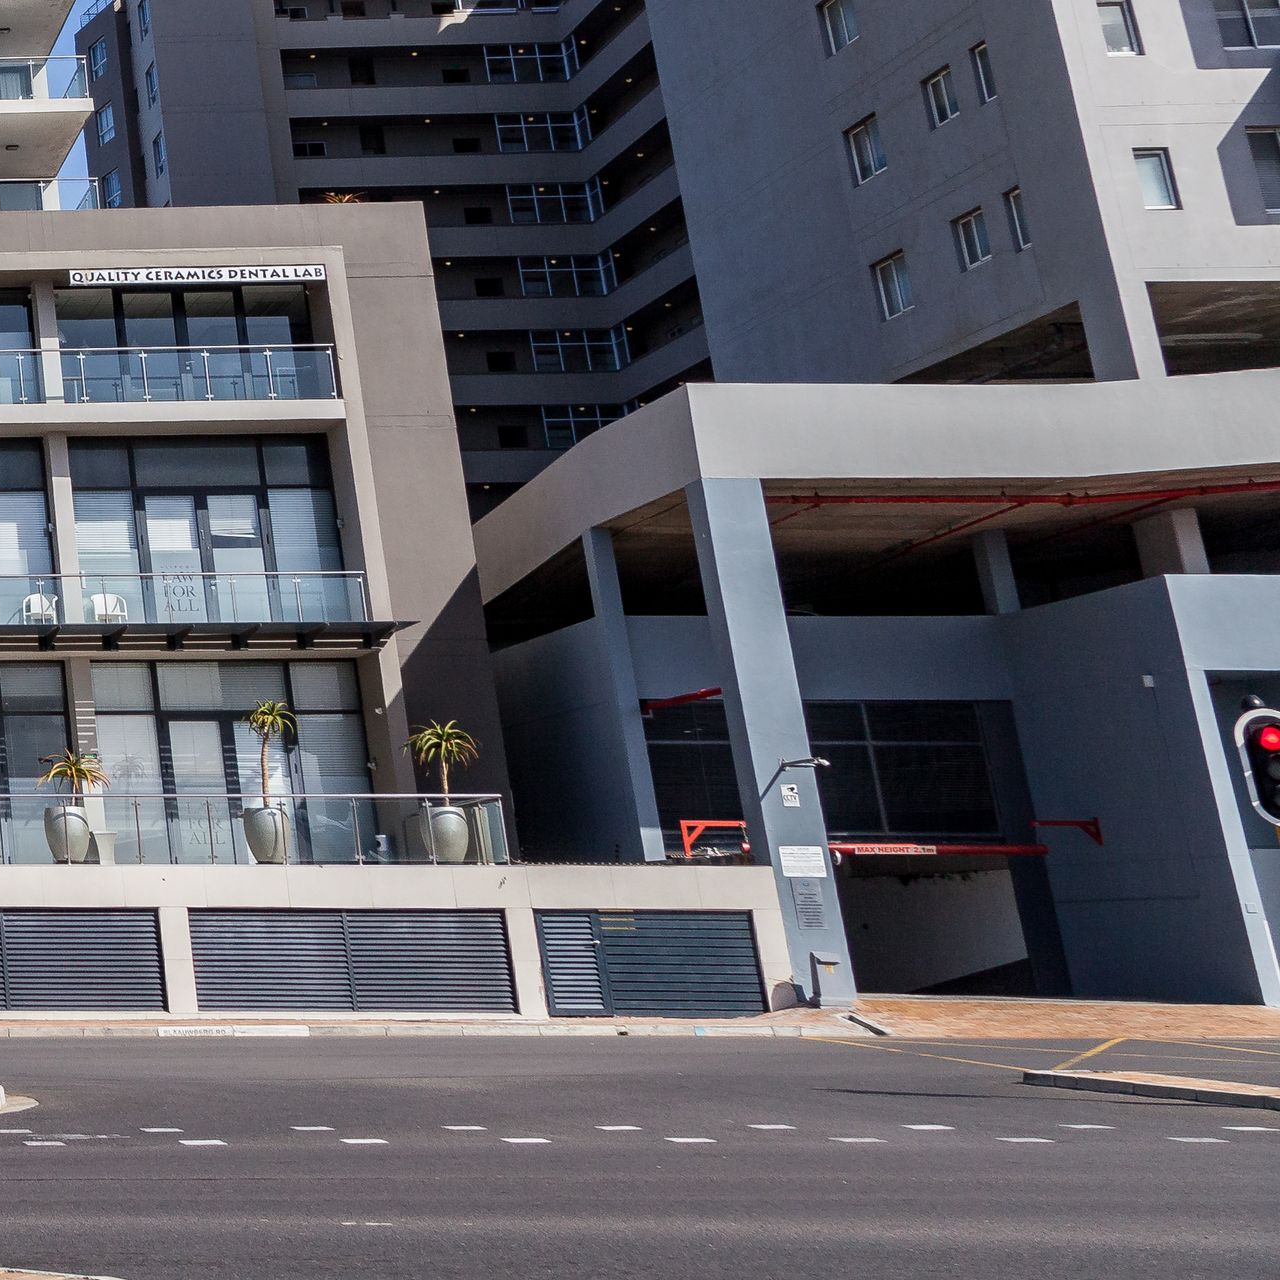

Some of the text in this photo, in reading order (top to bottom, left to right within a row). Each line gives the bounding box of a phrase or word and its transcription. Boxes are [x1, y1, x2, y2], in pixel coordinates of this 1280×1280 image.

[72, 267, 323, 283] QUALITY CERAMICS DENTAL LAB
